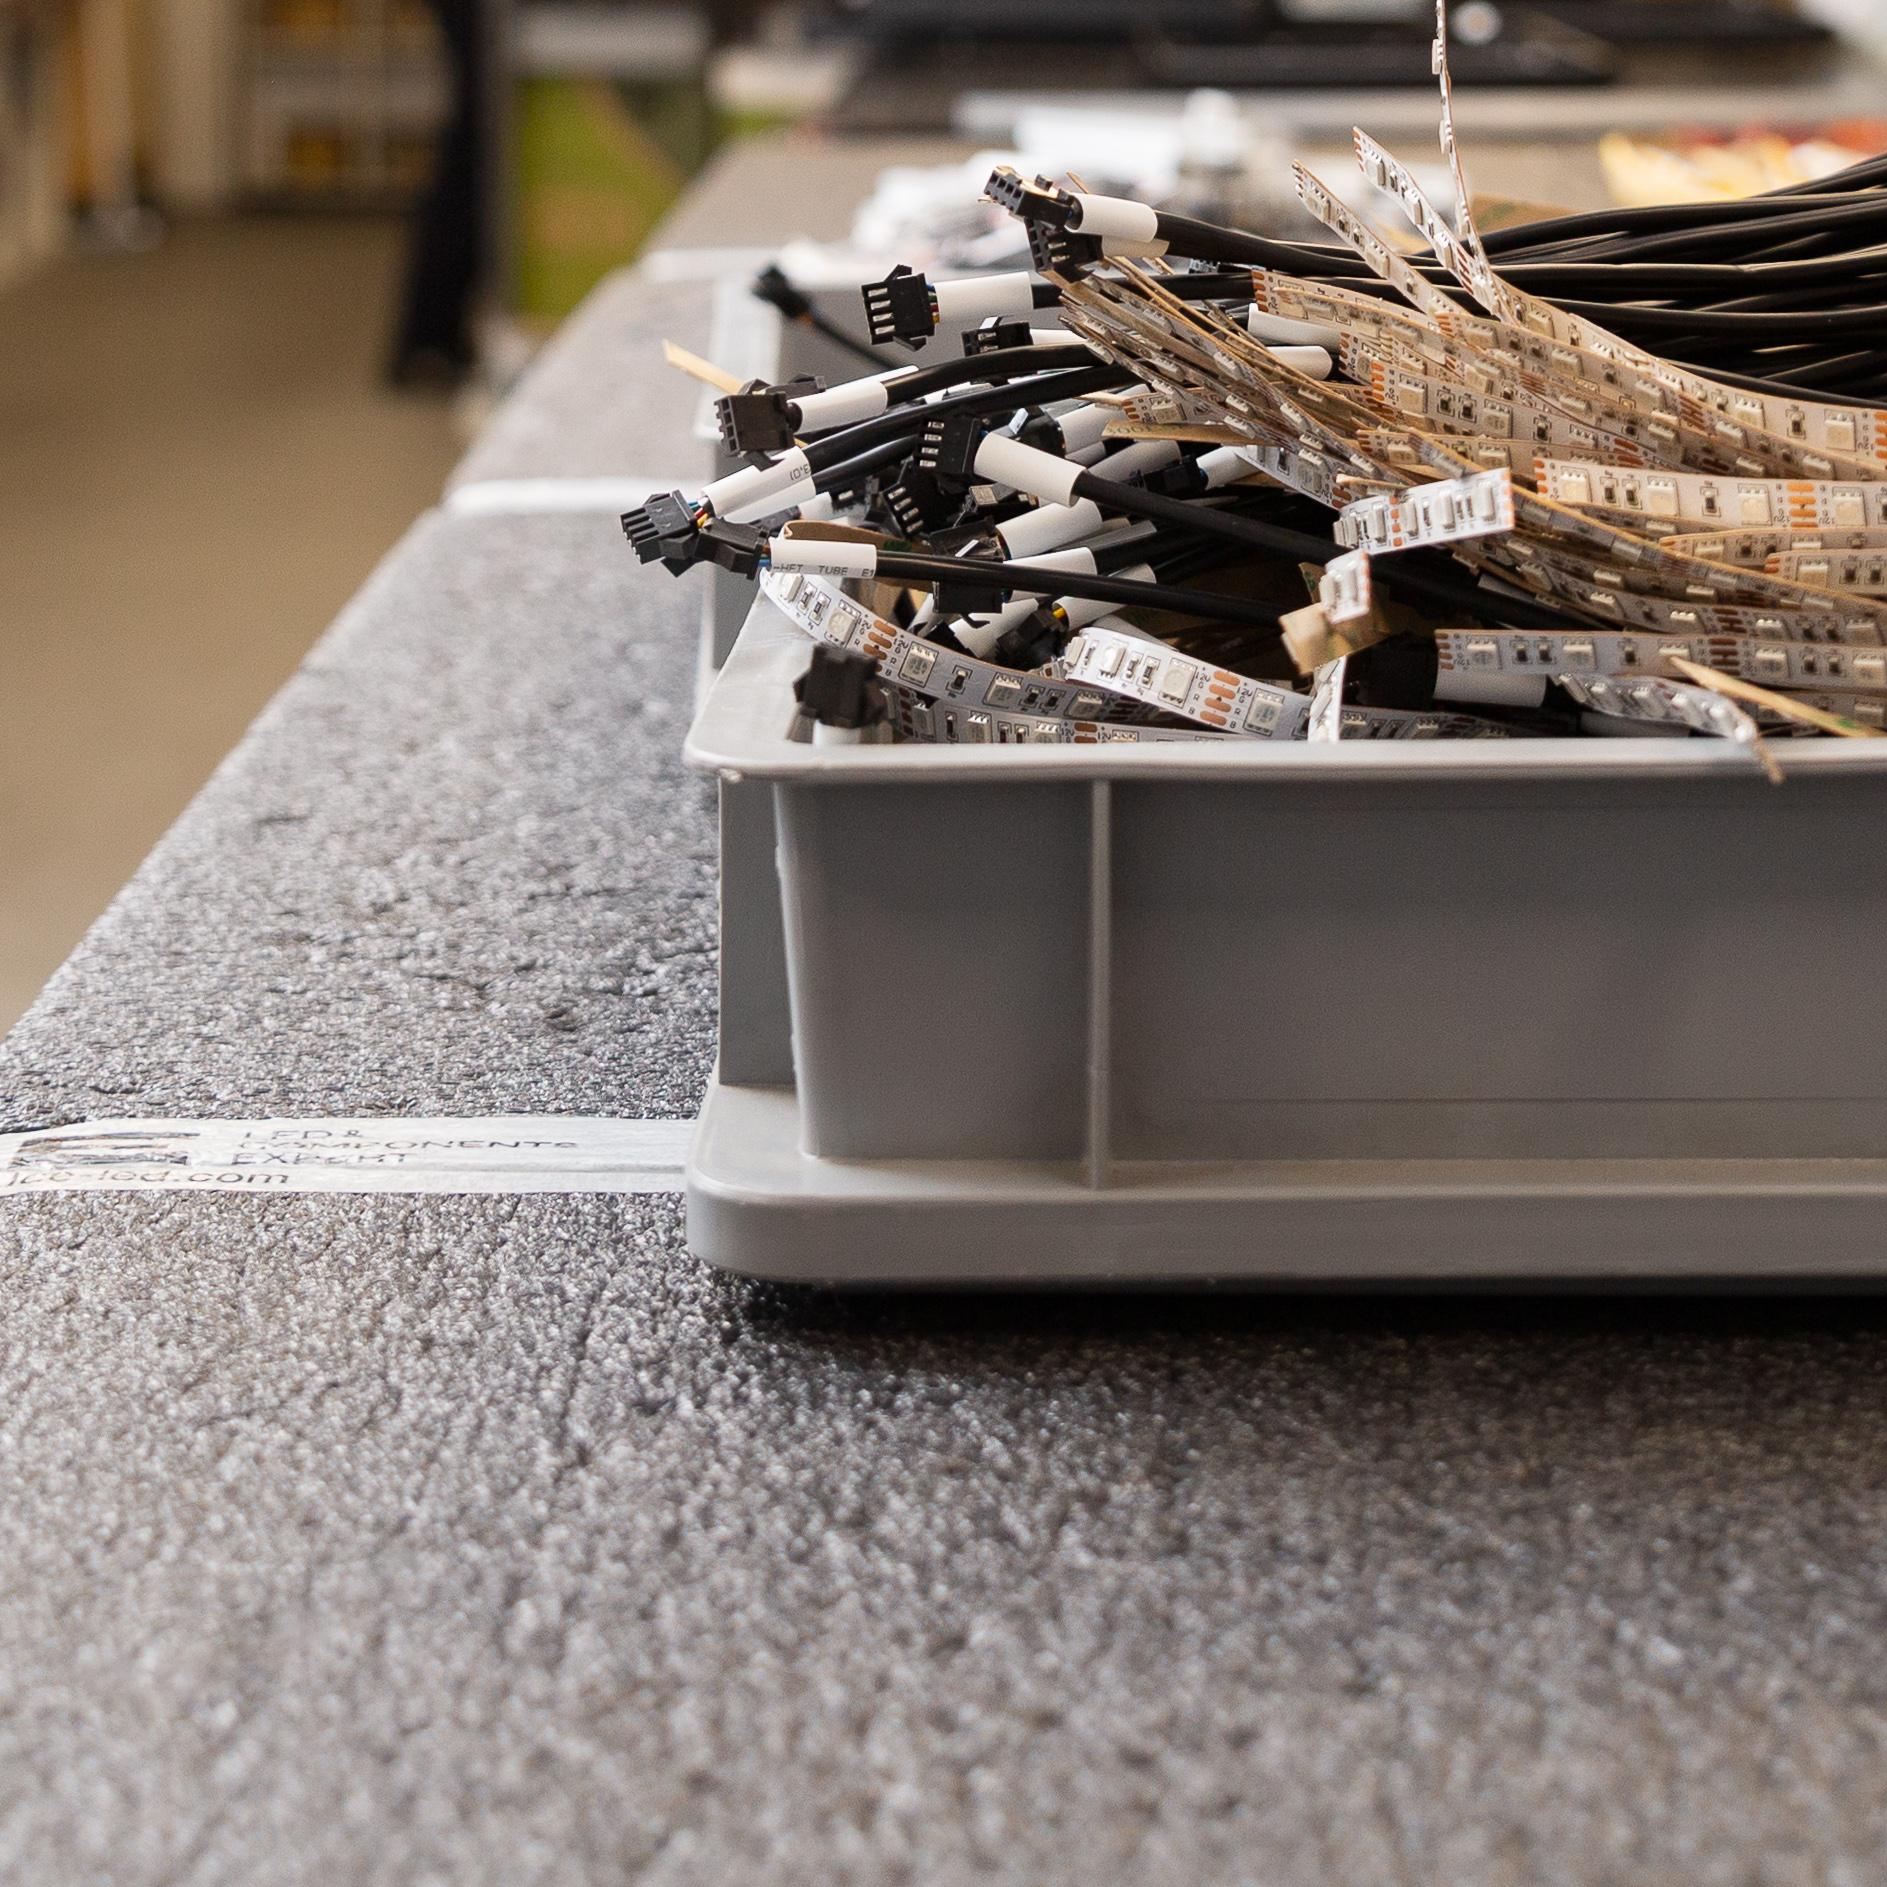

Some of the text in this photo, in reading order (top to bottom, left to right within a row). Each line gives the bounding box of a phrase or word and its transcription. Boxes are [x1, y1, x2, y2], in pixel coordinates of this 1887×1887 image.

[818, 565, 849, 576] TUBE
[857, 617, 871, 630] 12V
[893, 638, 909, 649] 12V
[1196, 671, 1211, 682] 12V
[1237, 686, 1254, 697] 12V
